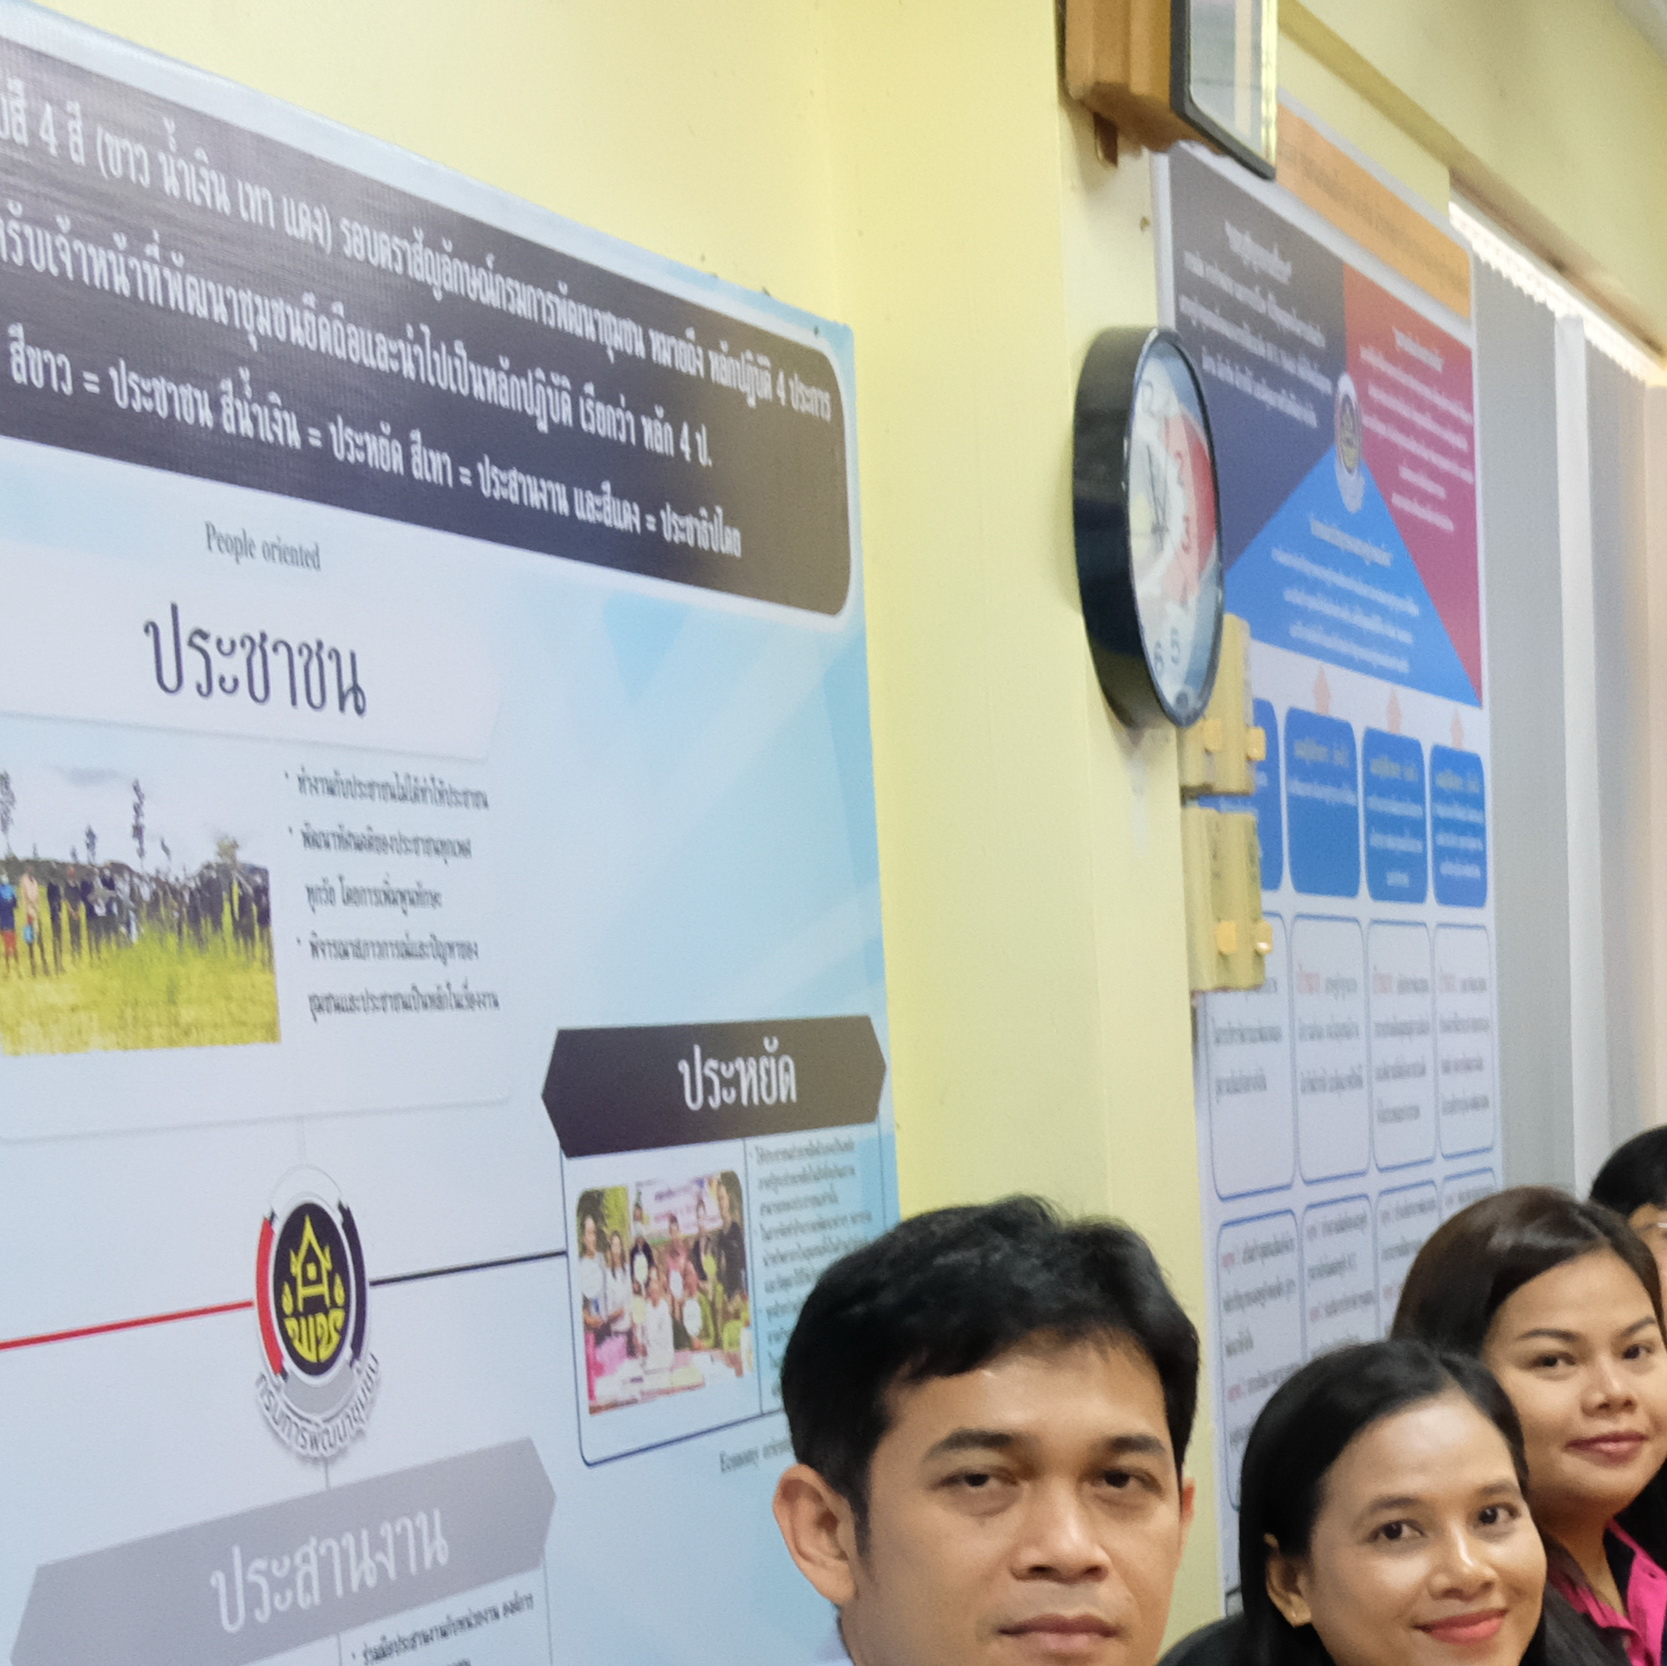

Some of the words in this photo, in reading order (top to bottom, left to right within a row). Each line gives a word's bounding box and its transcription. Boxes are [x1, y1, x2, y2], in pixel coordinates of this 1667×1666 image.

[39, 101, 58, 159] 4
[67, 100, 85, 167] สี
[97, 125, 150, 188] (ขาว
[158, 116, 231, 217] น้ำเงิน
[238, 179, 276, 231] เทา
[283, 194, 333, 255] แดง)
[649, 327, 705, 379] หมายถึง
[708, 340, 773, 410] หลักปฏิบัติ
[776, 368, 786, 407] 4
[788, 371, 832, 423] ประการ
[7, 322, 74, 396] สีขาว
[109, 357, 214, 430] ประชาชน
[220, 366, 302, 449] สีน้ำเงิน
[328, 413, 404, 476] ประหยัด
[410, 427, 453, 488] สีเทา
[477, 453, 570, 517] ประสานงาน
[573, 479, 642, 535] และสีแดง
[660, 500, 742, 559] ประชาธิปไตย
[579, 381, 637, 447] เรียกว่า
[641, 404, 675, 457] หลัก
[680, 421, 691, 463] 4
[695, 423, 713, 468] ป.
[205, 520, 257, 565] People
[261, 528, 322, 573] oriented
[142, 600, 367, 717] ประชาชน
[678, 1036, 798, 1112] ประหยัด
[209, 1507, 450, 1636] ประสานงาน
